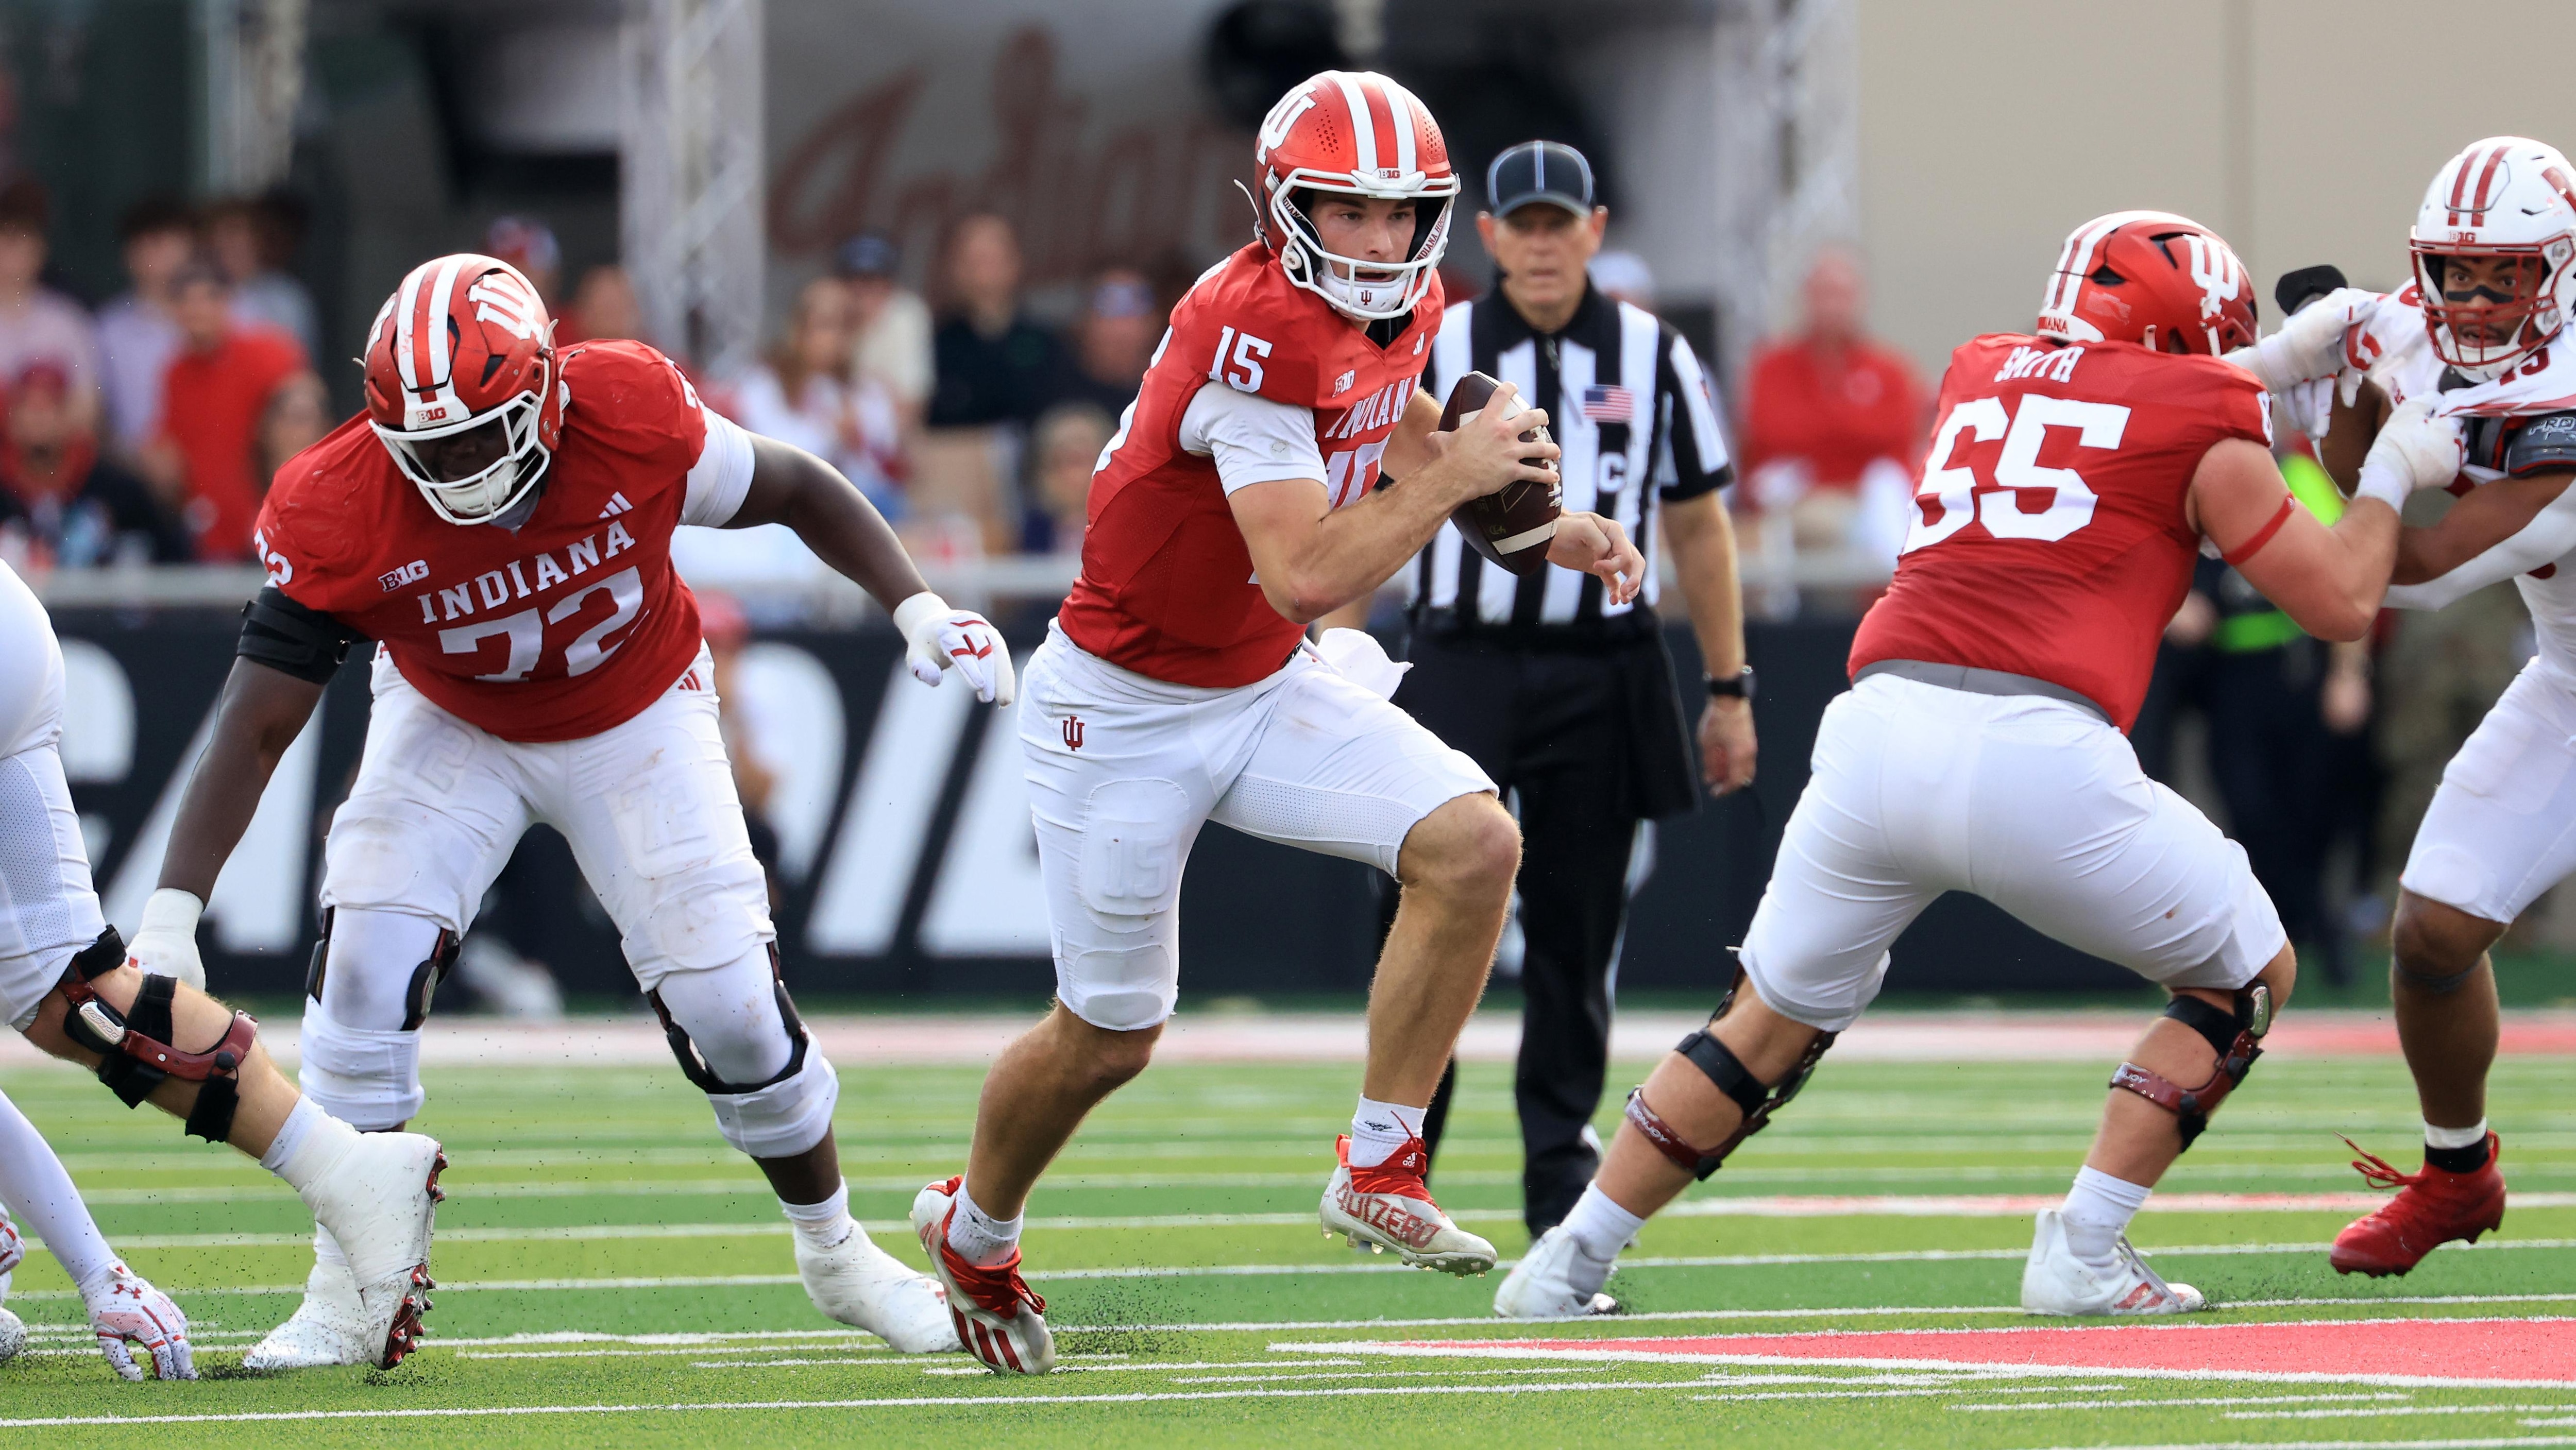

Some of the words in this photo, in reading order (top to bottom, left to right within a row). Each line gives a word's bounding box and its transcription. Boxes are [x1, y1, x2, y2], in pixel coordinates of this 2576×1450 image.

[1208, 325, 1273, 394] 15
[1993, 346, 2085, 383] SMITH
[1598, 452, 1626, 493] C
[1898, 393, 2132, 555] 65
[417, 520, 636, 624] INDIANA
[439, 566, 649, 683] 72
